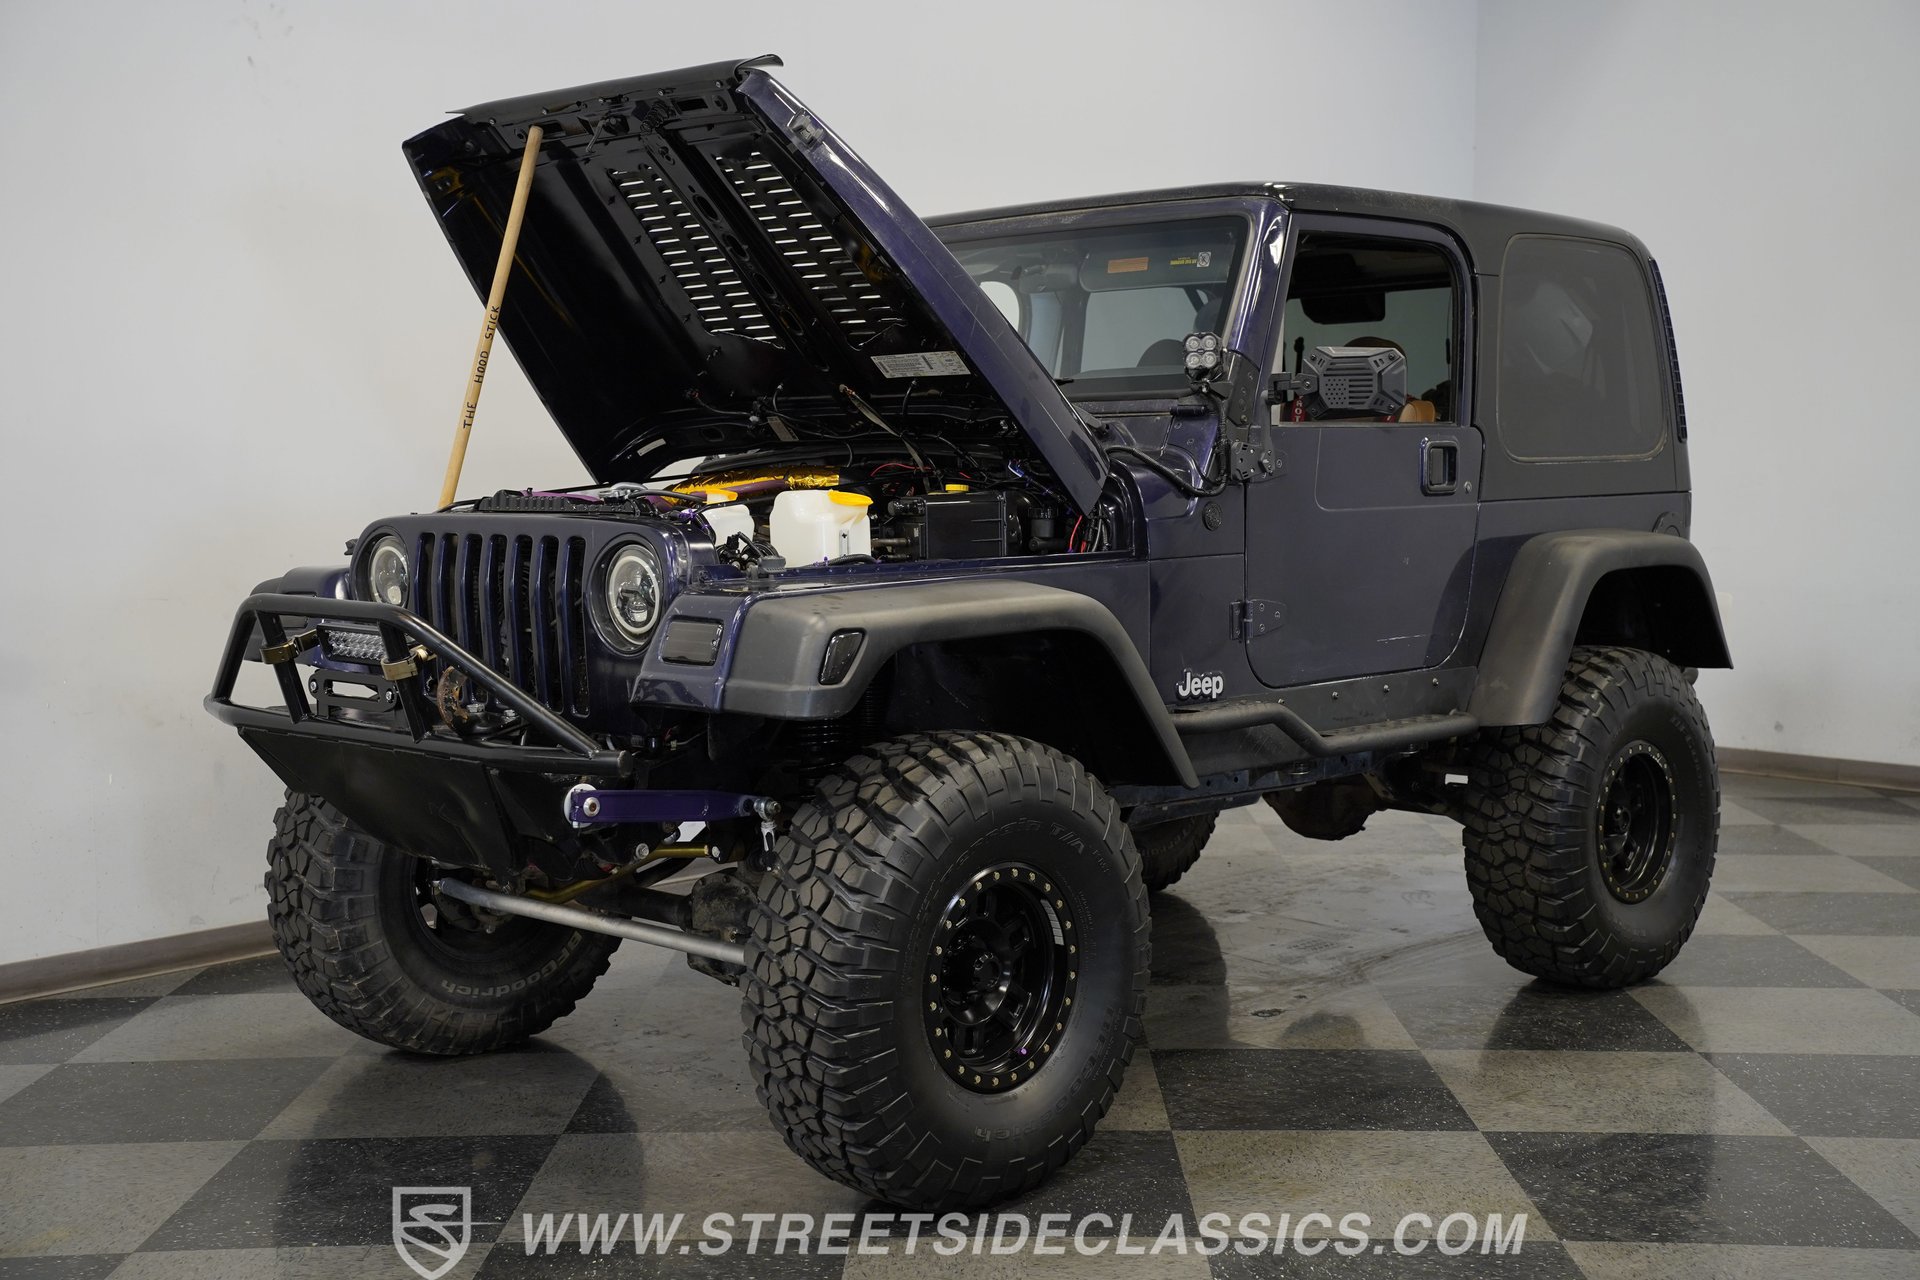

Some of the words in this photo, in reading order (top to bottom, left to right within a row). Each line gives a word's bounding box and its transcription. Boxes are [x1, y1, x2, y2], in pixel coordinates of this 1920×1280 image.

[463, 402, 477, 429] THE
[474, 350, 489, 384] HOOD
[484, 305, 500, 341] STICK
[1178, 671, 1224, 699] Jeep
